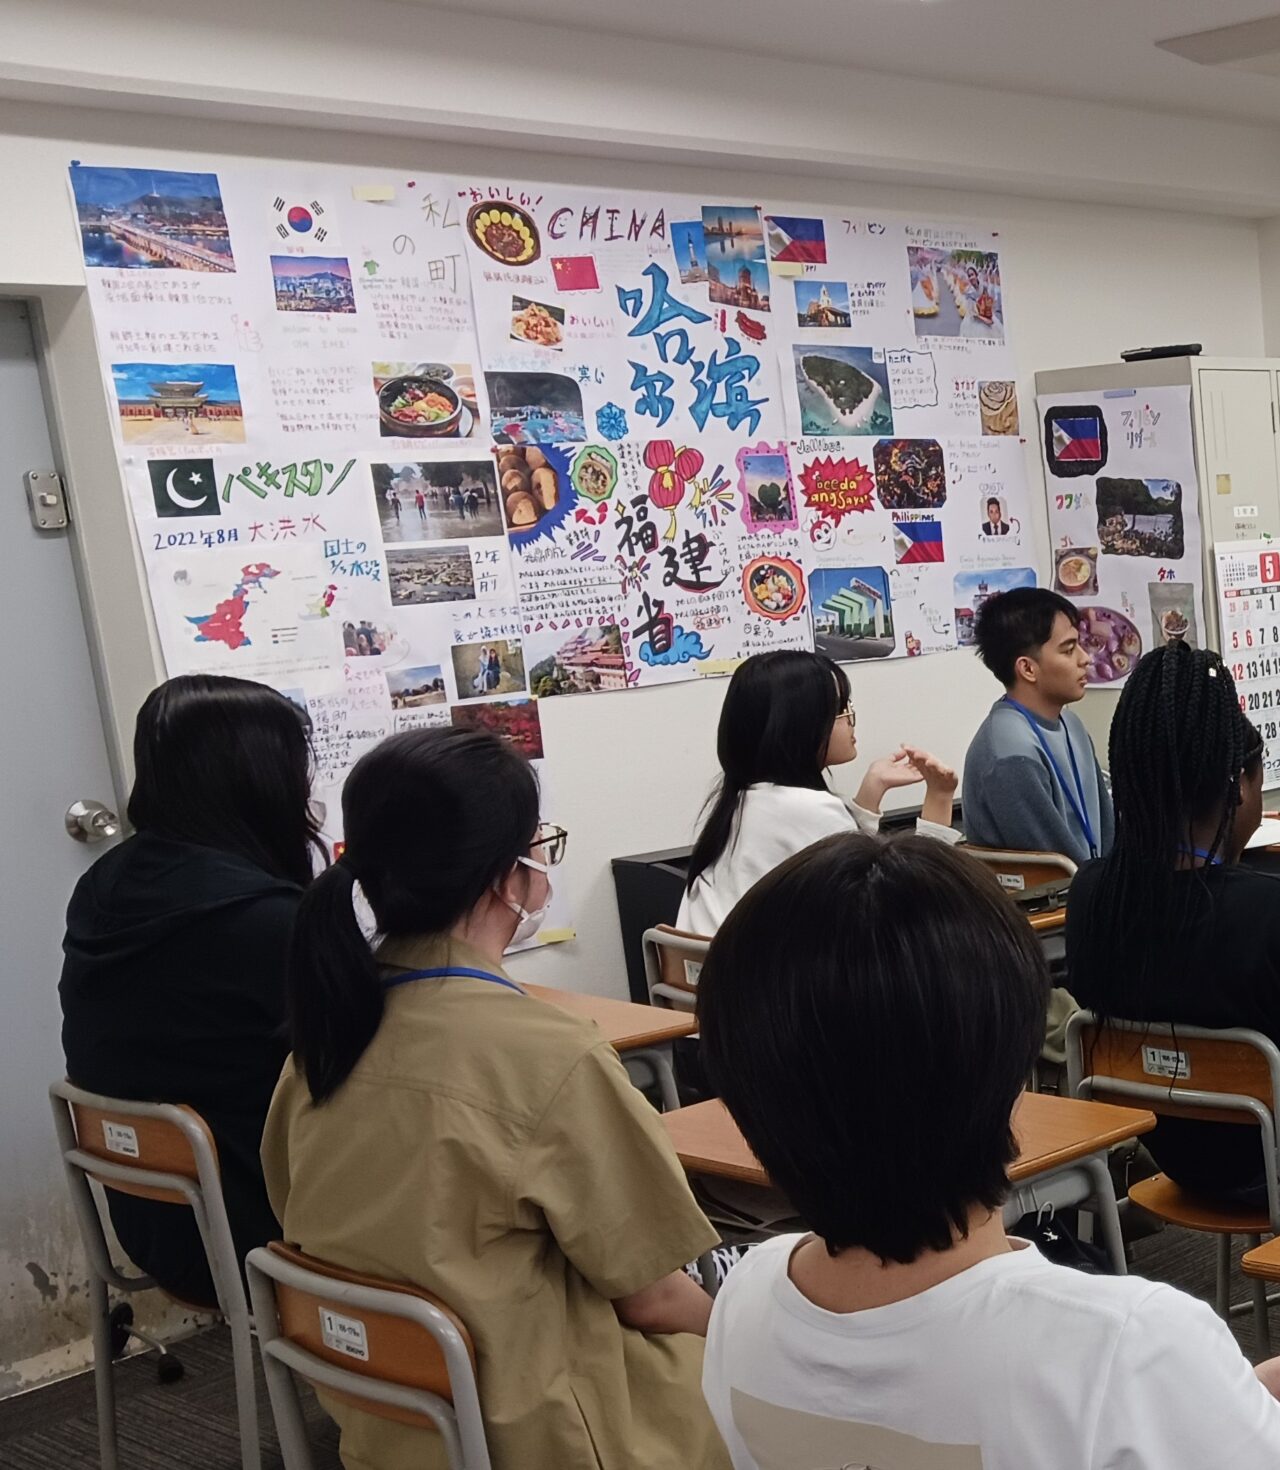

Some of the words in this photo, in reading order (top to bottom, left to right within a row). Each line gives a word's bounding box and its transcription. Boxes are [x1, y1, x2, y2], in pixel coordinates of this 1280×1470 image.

[548, 205, 666, 241] CHINA
[221, 458, 357, 503] パキスタン
[153, 527, 239, 551] 2022年8月
[248, 513, 328, 542] 大洪水
[323, 539, 367, 558] 国土の
[1265, 555, 1275, 580] 5
[1270, 594, 1275, 611] 1
[1232, 631, 1238, 648] 5
[1246, 629, 1252, 646] 6
[1259, 628, 1264, 644] 7
[1272, 626, 1279, 642] 8
[1232, 663, 1243, 680] 12
[1246, 661, 1257, 679] 13
[1260, 659, 1271, 676] 14
[1248, 693, 1260, 711] 20
[1262, 690, 1273, 708] 21
[1265, 722, 1277, 739] 28
[1150, 1051, 1156, 1062] 1
[327, 1316, 333, 1331] 1
